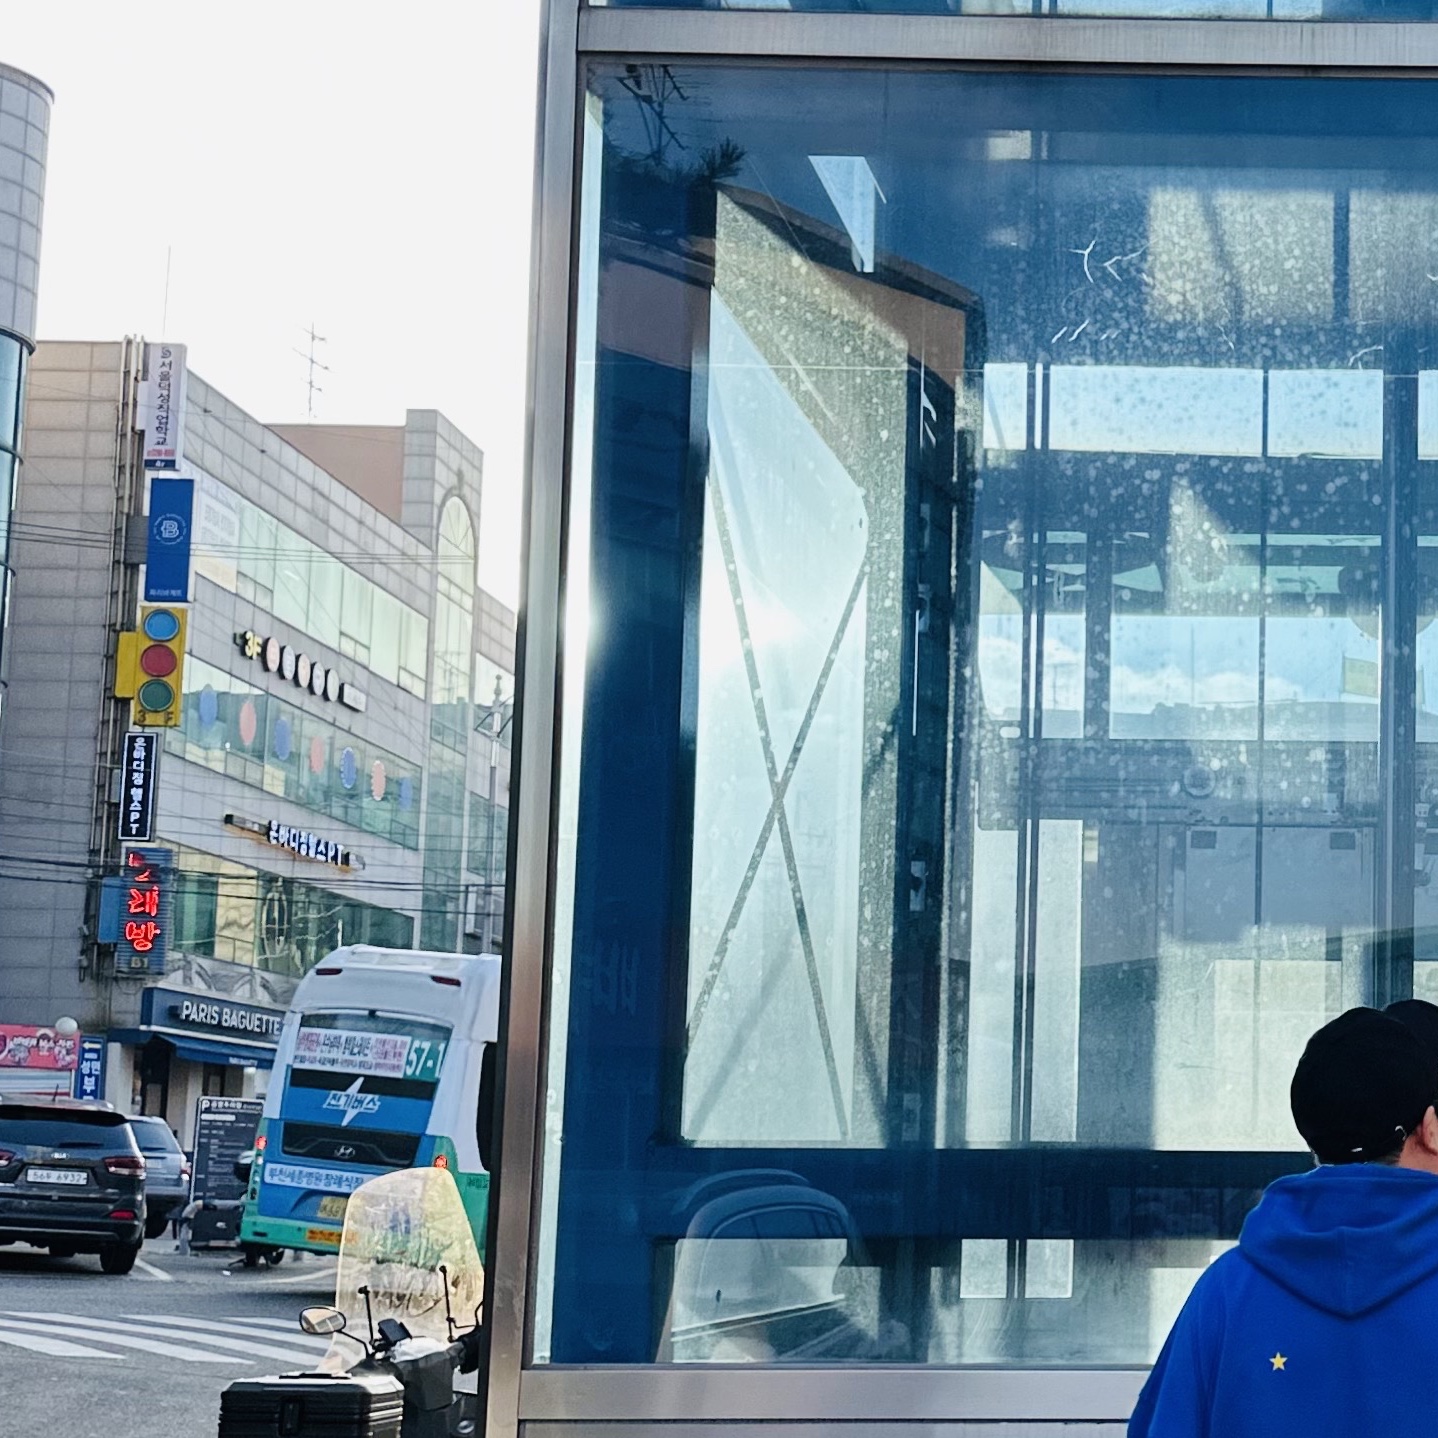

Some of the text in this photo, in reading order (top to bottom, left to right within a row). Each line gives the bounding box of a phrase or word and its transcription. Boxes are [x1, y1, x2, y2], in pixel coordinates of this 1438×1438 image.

[244, 630, 262, 660] 3F
[180, 1000, 281, 1035] PARIS BAGUETTE
[405, 1039, 446, 1078] 57-1
[325, 1092, 380, 1112] 전기버스
